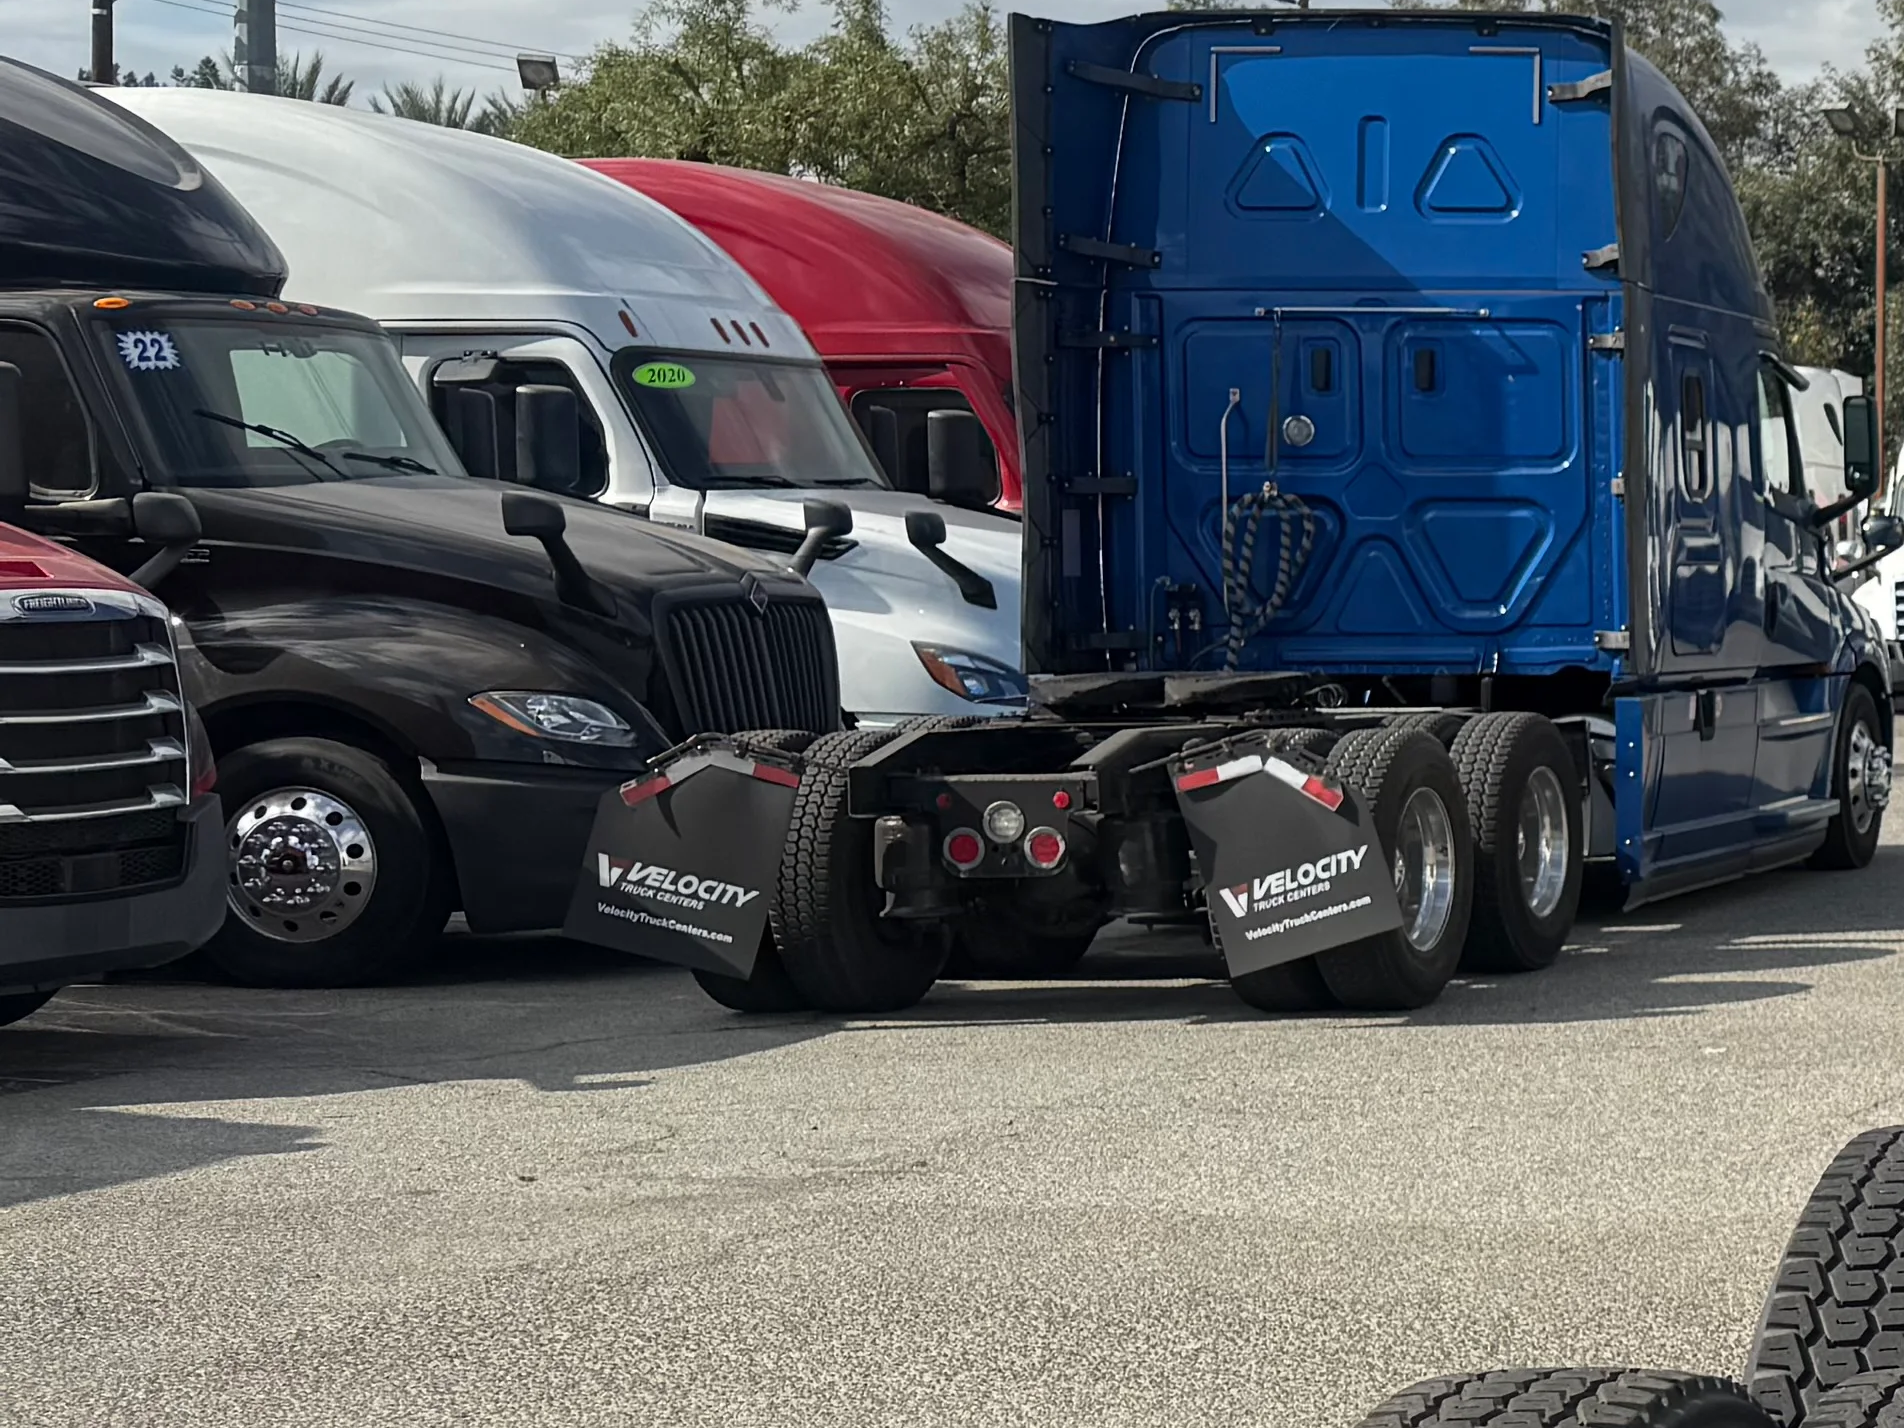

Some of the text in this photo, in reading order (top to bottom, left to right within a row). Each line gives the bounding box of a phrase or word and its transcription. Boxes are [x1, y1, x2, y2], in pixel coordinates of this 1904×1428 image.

[133, 337, 168, 363] 22
[647, 367, 685, 383] 2020
[626, 861, 760, 908] VELOCITY
[1252, 844, 1369, 901] VELOCITY
[619, 881, 705, 910] TRUCK CENTERS
[1253, 881, 1331, 912] TRUCK CENTERS
[597, 902, 733, 943] VelocityTruckCenters.com
[1245, 895, 1372, 940] VelocityTruckCenters.com
